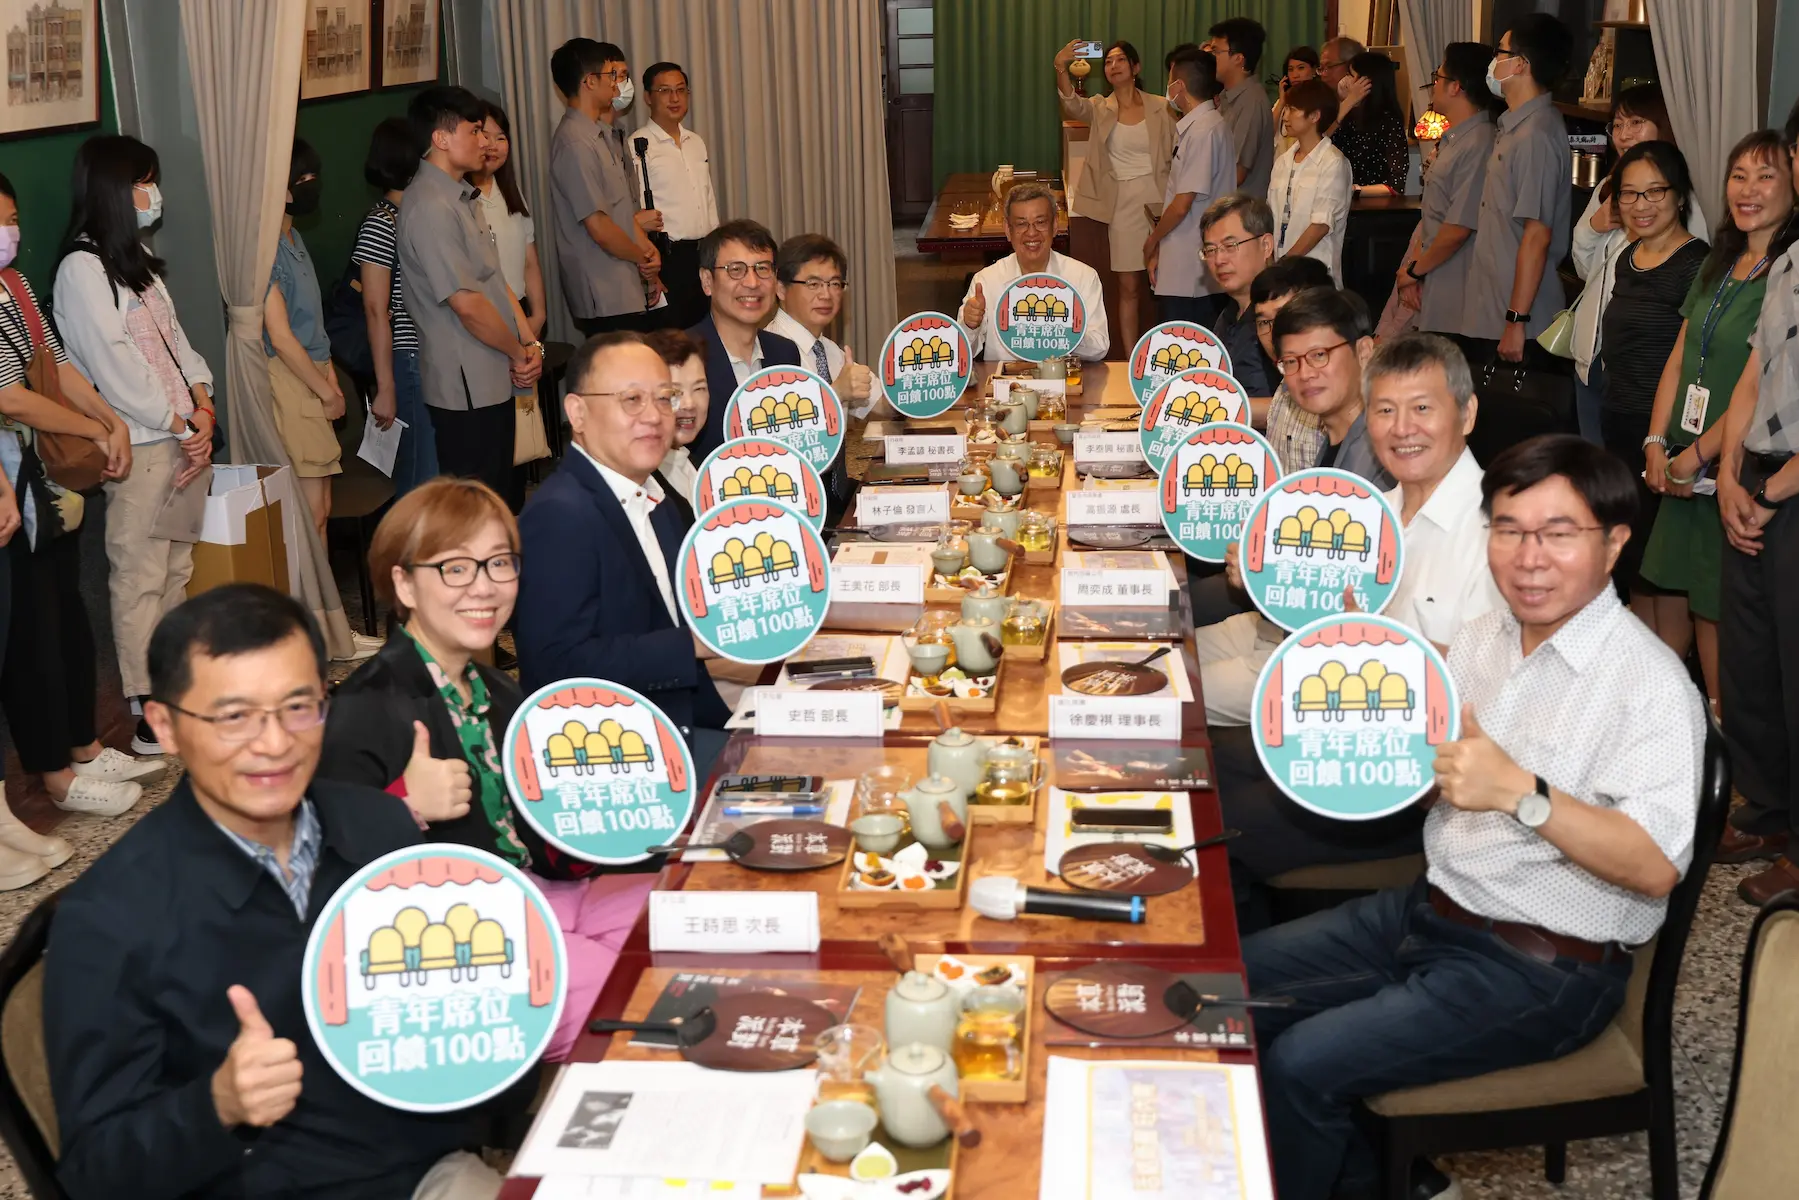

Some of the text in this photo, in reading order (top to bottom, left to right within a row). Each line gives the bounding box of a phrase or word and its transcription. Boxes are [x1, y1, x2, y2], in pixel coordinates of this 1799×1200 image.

[1015, 324, 1066, 337] 青年席位
[1011, 337, 1070, 350] 回饋100點
[901, 370, 952, 389] 青年席位
[897, 385, 956, 405] 回饋100點
[928, 445, 956, 455] 秘書長
[871, 503, 937, 516] 林子倫 發言人
[1120, 503, 1141, 514] 處長
[1185, 500, 1254, 521] 青年席位
[1179, 522, 1242, 540] 回饋100
[1274, 559, 1364, 591] 青年席位
[839, 580, 901, 592] 王美花 部長
[1077, 583, 1153, 595] 周奕成 董事長
[718, 582, 804, 621] 青年席位
[716, 605, 815, 647] 回饋100點
[789, 708, 848, 722] 史哲 部長
[1118, 713, 1162, 727] 理事長
[1297, 727, 1412, 758] 青年席位
[1289, 759, 1422, 787] 回饋100點
[556, 777, 661, 809] 青年席位
[552, 804, 676, 837] 回饋100點
[684, 916, 781, 934] 王時思 次長
[367, 987, 513, 1036] 青年席位
[357, 1024, 526, 1076] 回饋100點
